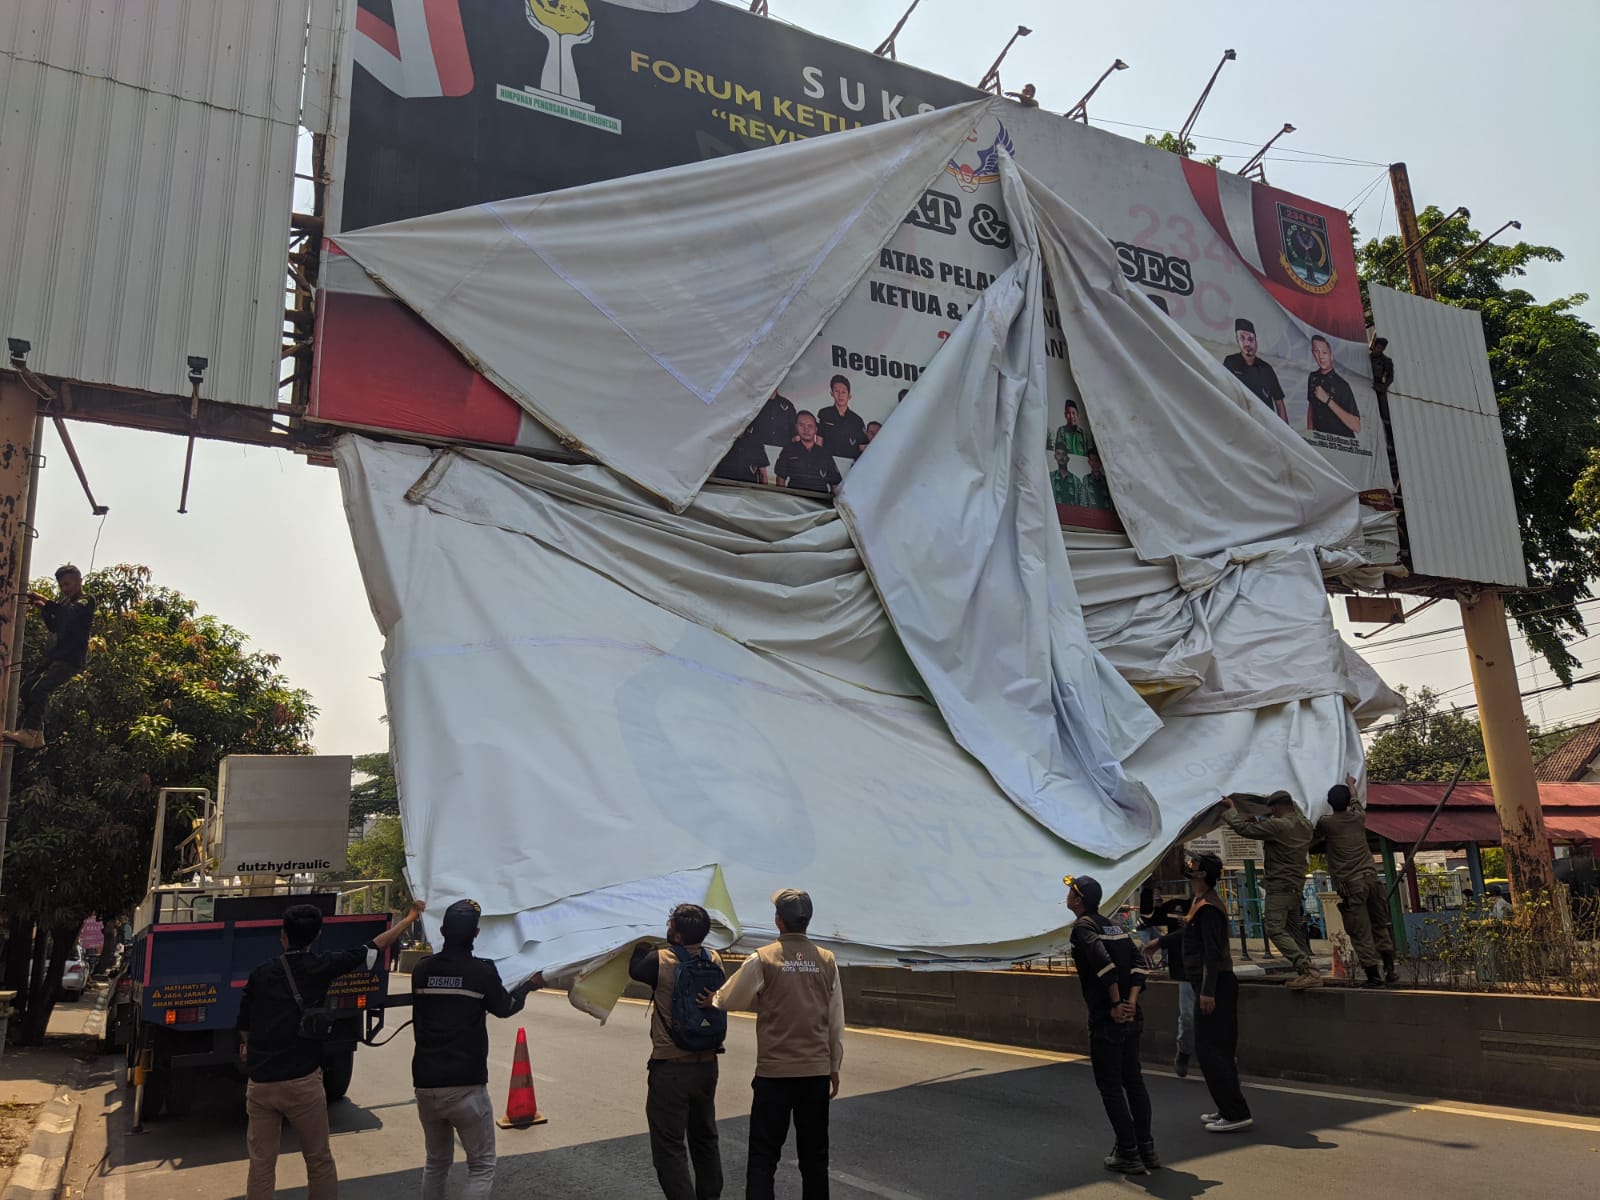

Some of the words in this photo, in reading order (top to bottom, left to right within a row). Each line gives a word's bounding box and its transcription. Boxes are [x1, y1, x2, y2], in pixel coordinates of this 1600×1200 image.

[631, 50, 762, 112] FORUM
[968, 203, 1011, 249] &
[880, 248, 934, 279] ATAS
[870, 281, 942, 317] KETUA
[947, 302, 963, 322] &
[237, 859, 331, 873] dutzhydraulic
[428, 976, 463, 988] DISHUB
